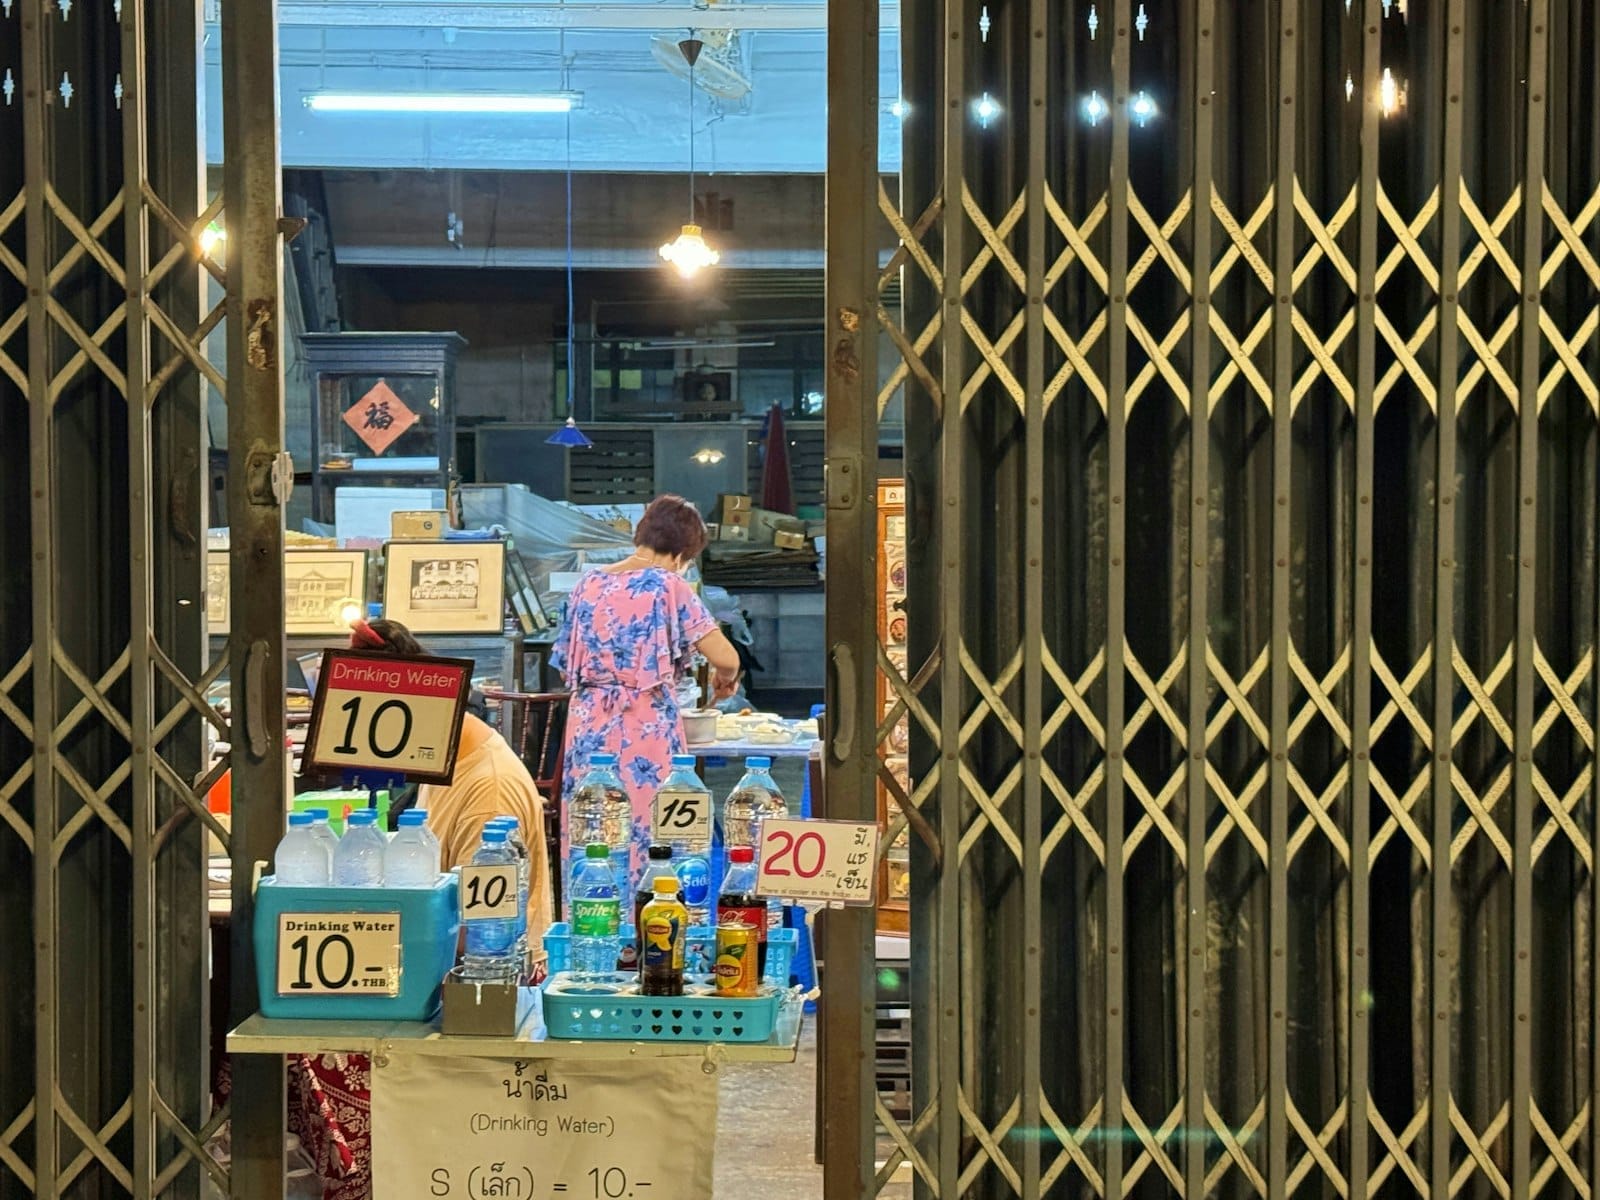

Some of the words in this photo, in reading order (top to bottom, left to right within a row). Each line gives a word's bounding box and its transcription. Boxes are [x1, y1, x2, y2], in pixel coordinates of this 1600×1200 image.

[363, 401, 394, 430] 福
[333, 662, 401, 688] Drinking
[406, 669, 457, 688] Water
[286, 921, 349, 933] Drinking
[352, 921, 395, 932] Water
[470, 1112, 548, 1137] (Drinking
[556, 1115, 615, 1138] Water)
[430, 1168, 450, 1197] S
